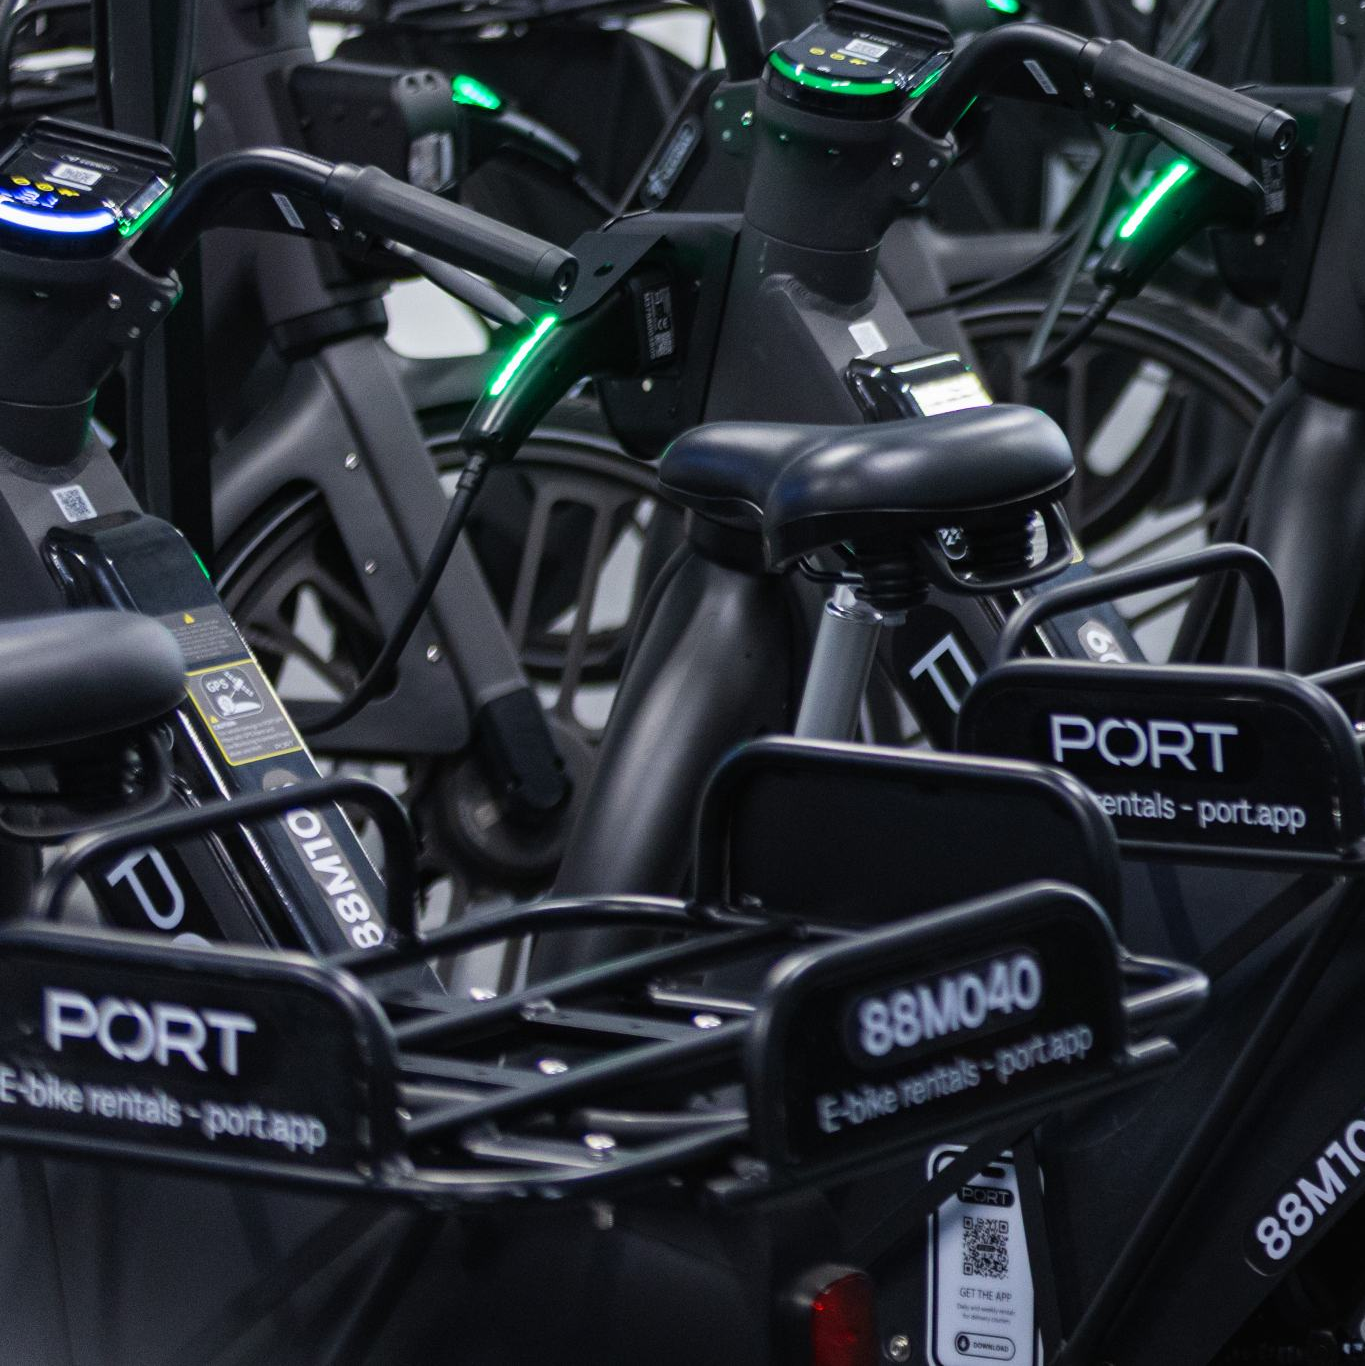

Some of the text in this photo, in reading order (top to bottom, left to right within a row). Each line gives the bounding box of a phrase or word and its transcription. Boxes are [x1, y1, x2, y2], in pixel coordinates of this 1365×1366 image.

[205, 679, 229, 693] GPS
[1050, 715, 1238, 772] PORT
[1198, 797, 1306, 835] port.app
[284, 804, 385, 949] 88M10
[43, 987, 257, 1076] PORT
[859, 954, 1042, 1057] 88M040
[816, 1085, 899, 1134] E-bike
[899, 1057, 980, 1108] rentals
[996, 1024, 1094, 1084] port.app
[0, 1064, 84, 1113] E-bike
[85, 1086, 183, 1128] rentals
[201, 1100, 327, 1155] port.app
[961, 1187, 1010, 1205] PORT
[959, 1287, 1012, 1302] GET THE APP
[973, 1342, 1010, 1353] DOWNLOAD
